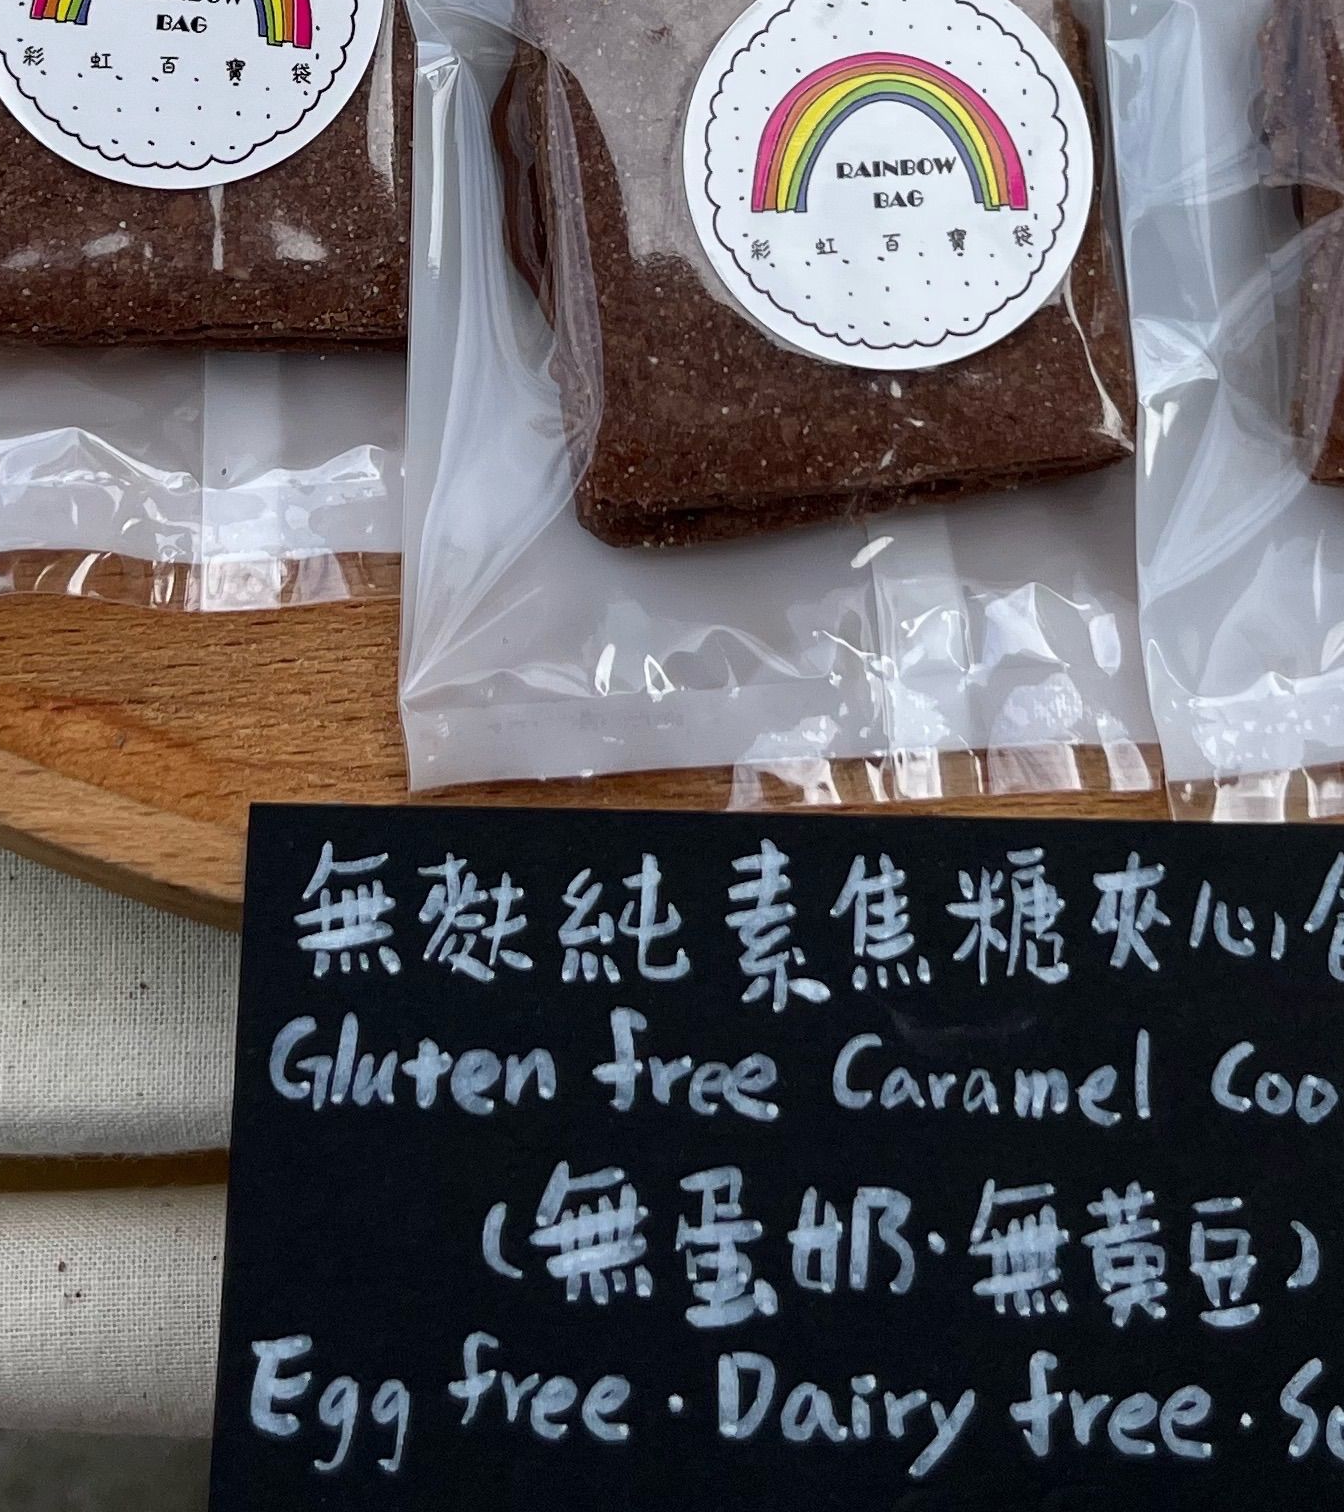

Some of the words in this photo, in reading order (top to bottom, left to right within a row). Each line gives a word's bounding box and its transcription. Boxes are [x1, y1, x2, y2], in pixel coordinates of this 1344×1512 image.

[155, 13, 208, 34] BAG
[836, 156, 958, 180] RAINBOW
[873, 189, 924, 209] BAG
[269, 1012, 553, 1112] Gluten
[593, 1008, 779, 1120] free
[833, 1030, 1150, 1123] Caramel
[250, 1334, 412, 1472] Egg
[448, 1331, 631, 1440] free
[718, 1351, 975, 1478] Dairy
[1009, 1349, 1213, 1457] free
